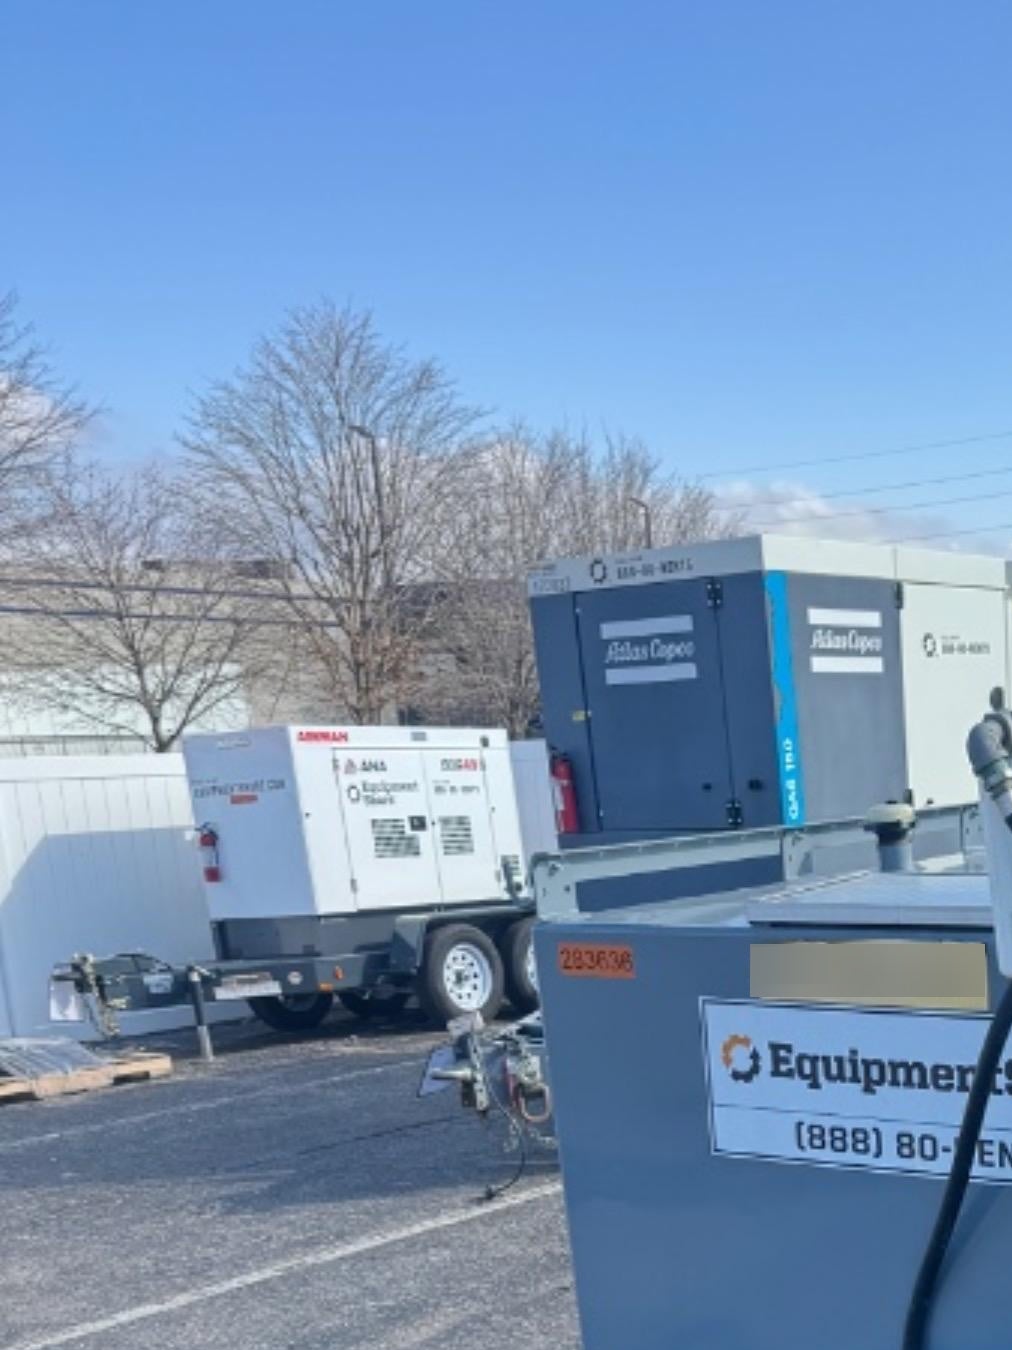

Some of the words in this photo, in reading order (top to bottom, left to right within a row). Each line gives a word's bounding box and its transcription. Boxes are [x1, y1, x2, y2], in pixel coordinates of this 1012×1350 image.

[605, 640, 648, 663] Atlas
[650, 639, 694, 659] Copco
[810, 629, 846, 650] Atlas
[847, 630, 882, 654] Copco
[560, 948, 634, 973] 283636
[795, 1120, 883, 1160] (888)
